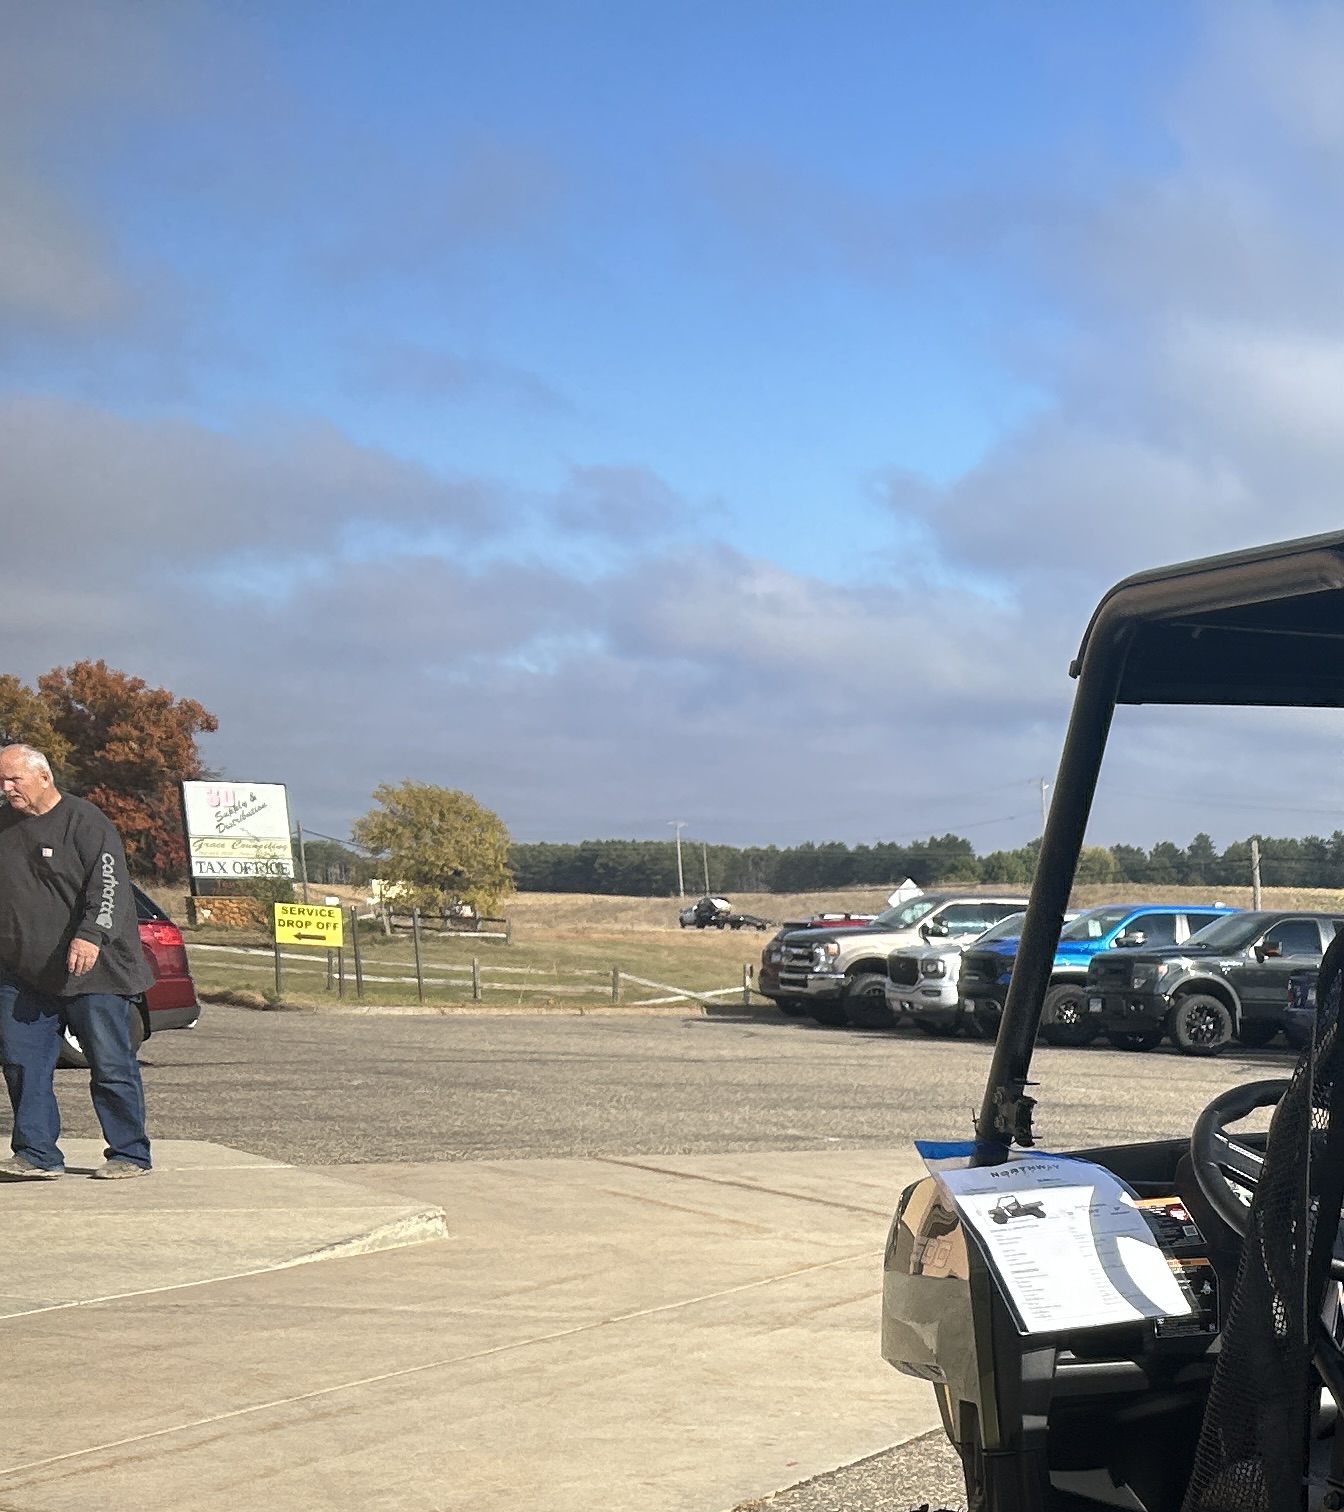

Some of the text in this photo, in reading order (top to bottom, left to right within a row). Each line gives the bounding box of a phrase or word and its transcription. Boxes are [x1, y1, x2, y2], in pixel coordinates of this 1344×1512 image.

[195, 861, 291, 876] TAX OFFICE
[281, 906, 335, 918] SERVICE
[277, 918, 339, 931] DROP OFF
